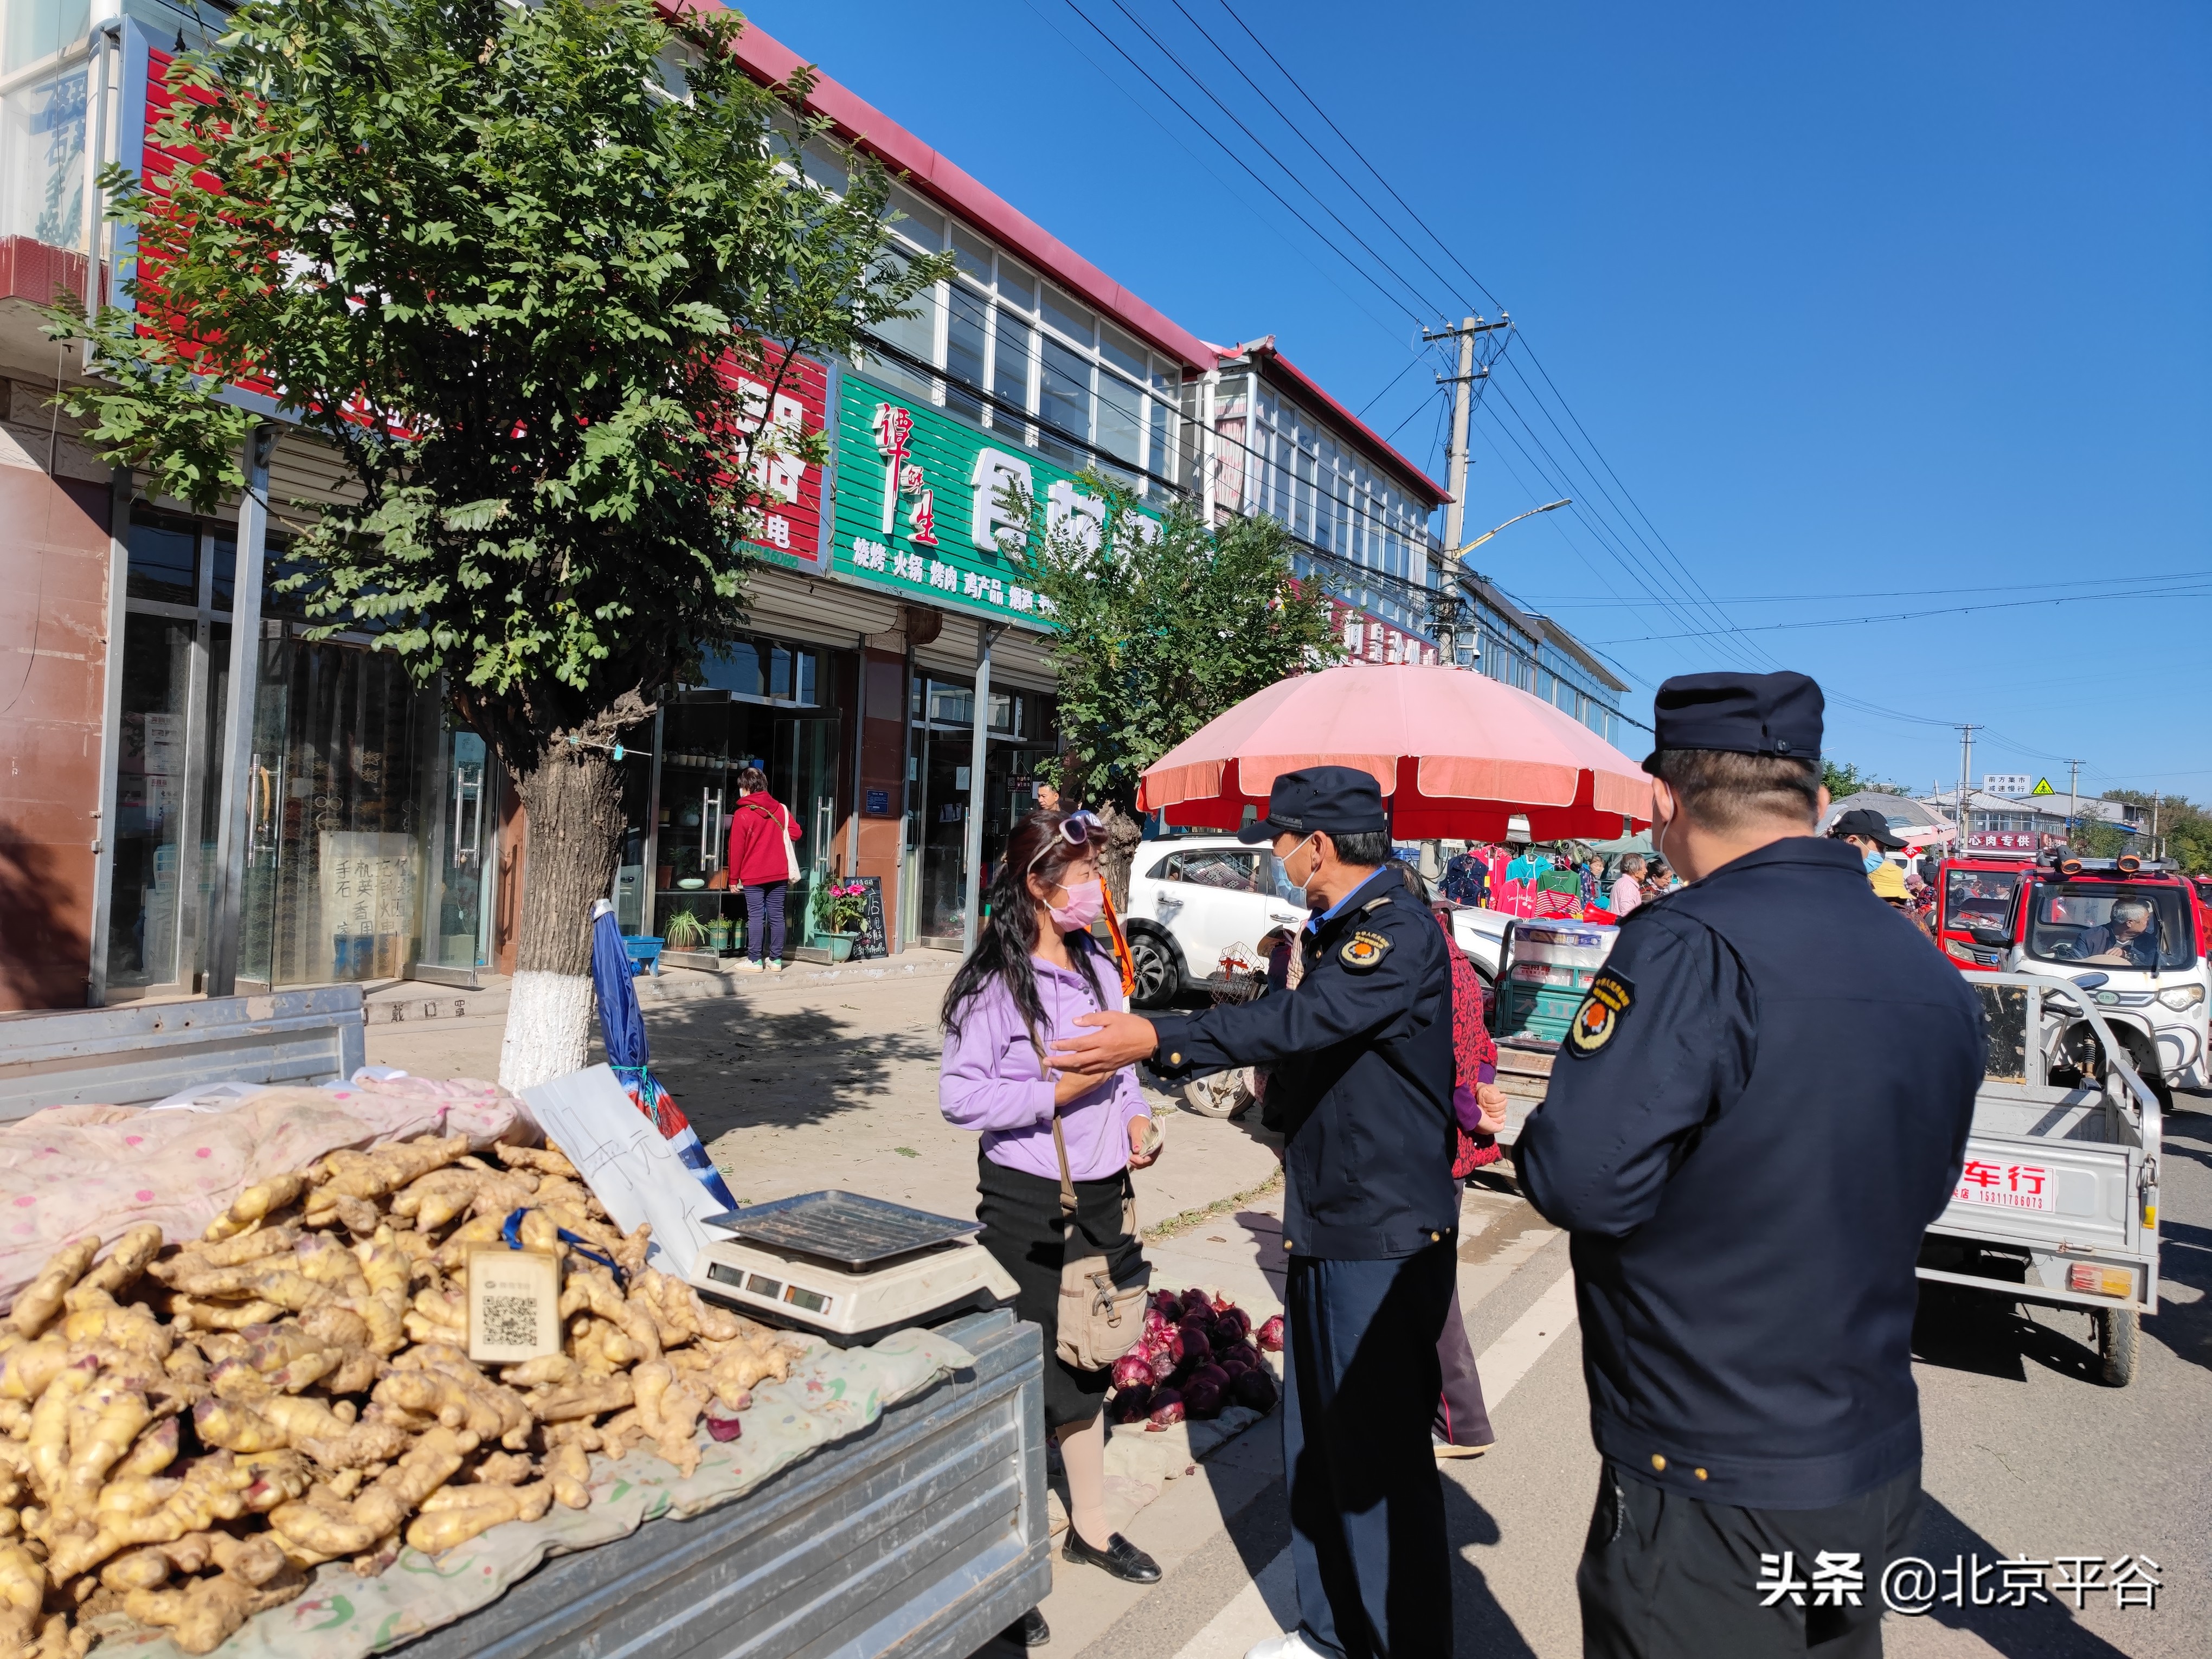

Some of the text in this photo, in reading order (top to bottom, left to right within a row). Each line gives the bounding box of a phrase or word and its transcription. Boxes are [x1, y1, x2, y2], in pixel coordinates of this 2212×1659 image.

[853, 537, 886, 571] 烧烤
[893, 550, 923, 582] 火锅
[930, 560, 957, 592] 烤肉
[1953, 835, 2030, 847] 心肉专供
[1964, 1161, 2045, 1194] 车行
[1979, 1190, 2042, 1209] 15311786073
